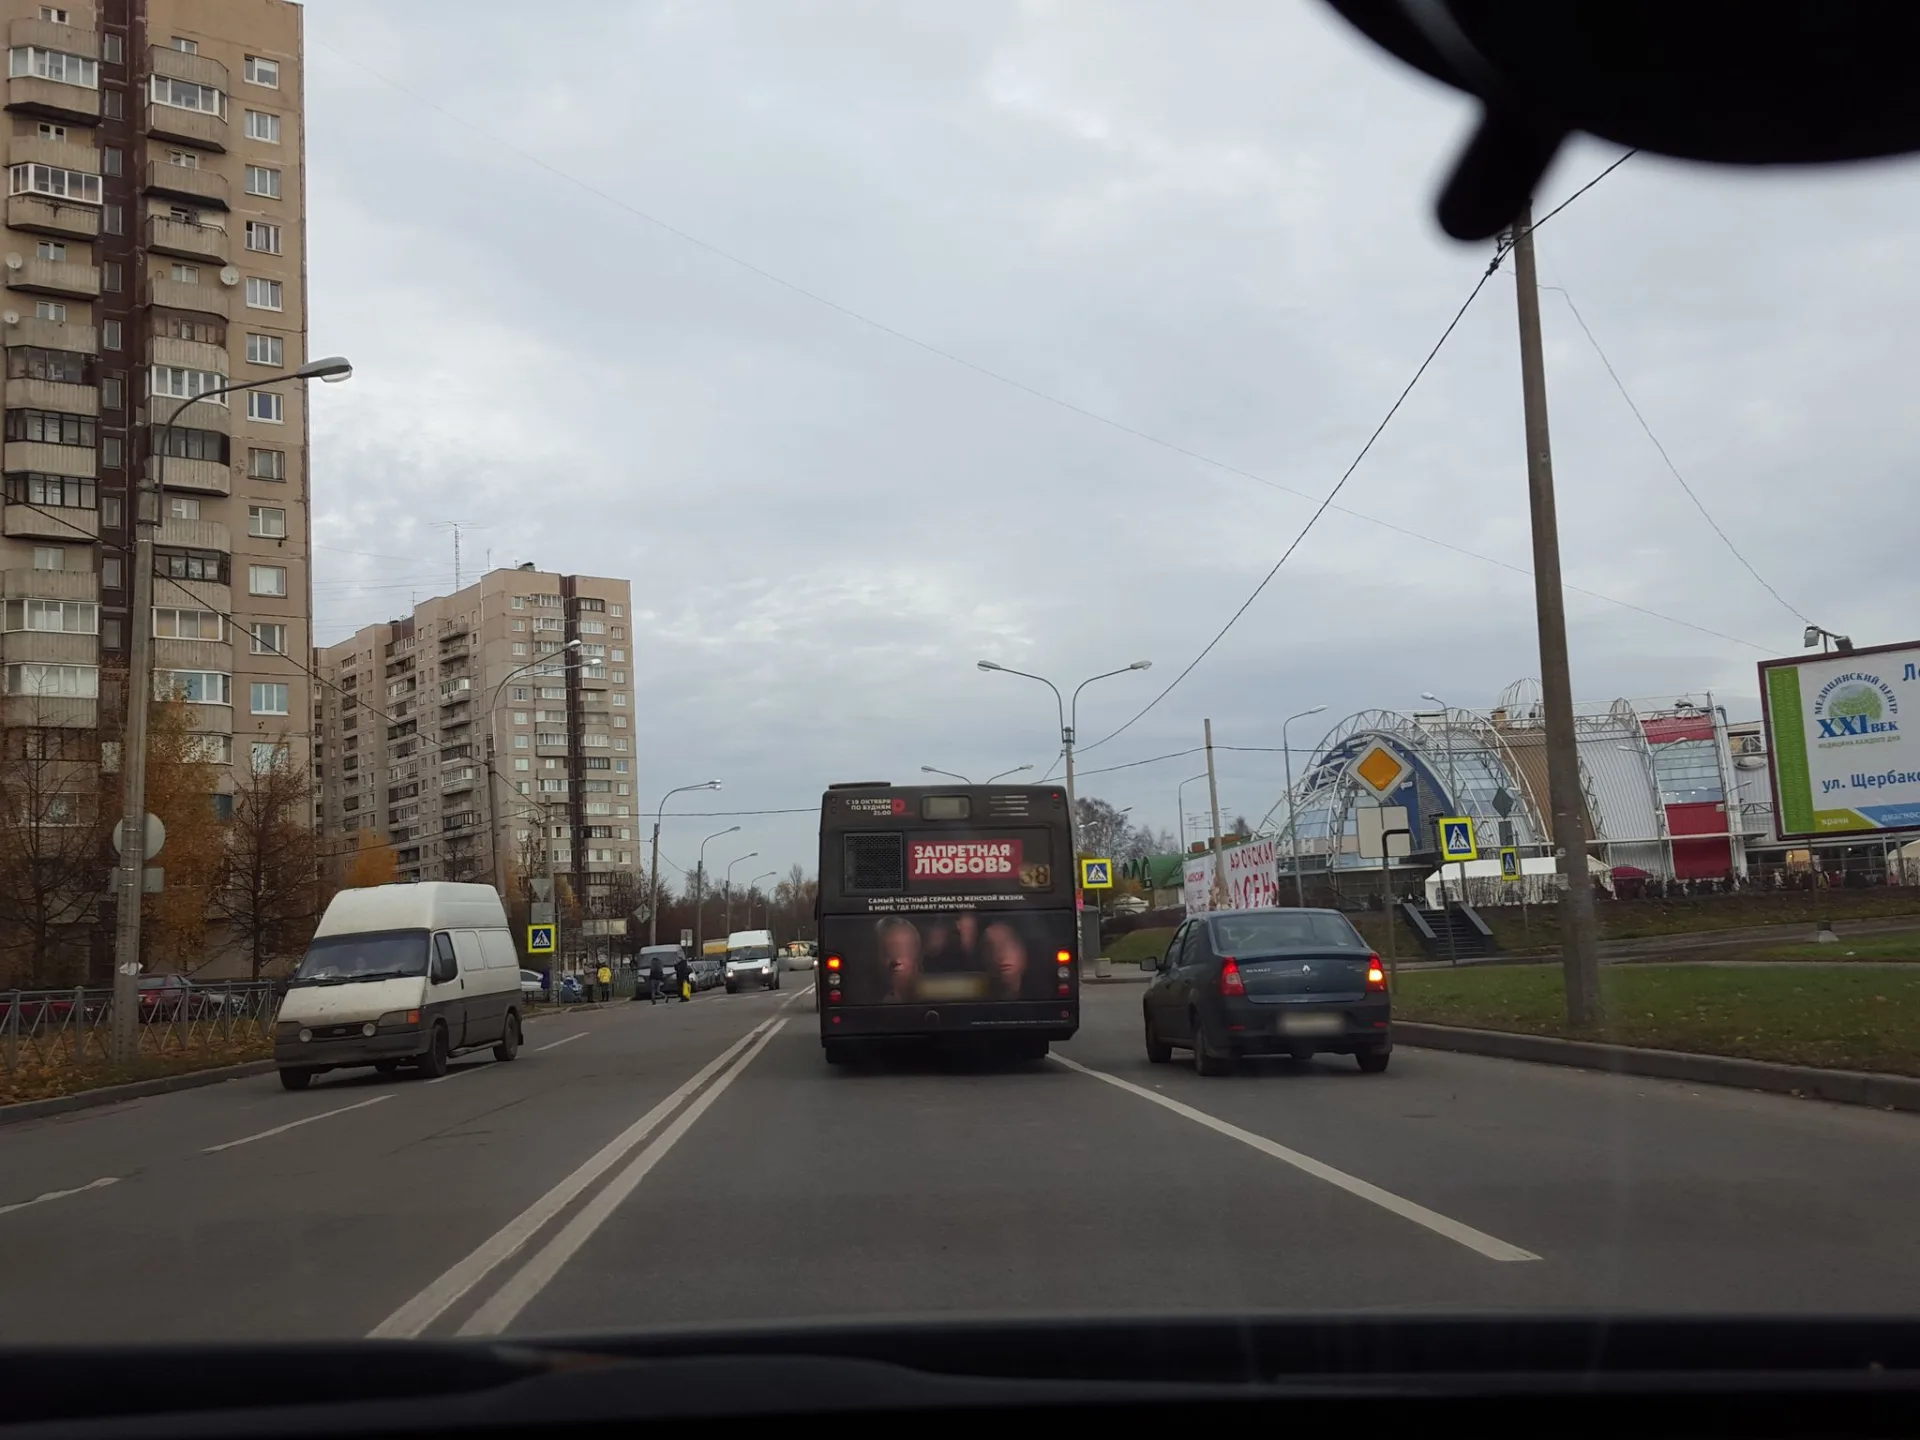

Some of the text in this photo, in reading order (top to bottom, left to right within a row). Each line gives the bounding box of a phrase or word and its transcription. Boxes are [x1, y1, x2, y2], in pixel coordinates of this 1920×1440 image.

[1902, 663, 1920, 682] Л
[1814, 672, 1898, 715] МЕДИЦИНСКИЙ ЦЕНТР
[1816, 713, 1899, 739] XXI ВЕК
[1822, 778, 1846, 793] ул.
[914, 844, 1010, 859] ЗАПРЕТНАЯ
[914, 857, 1012, 875] ЛЮБОВЬ
